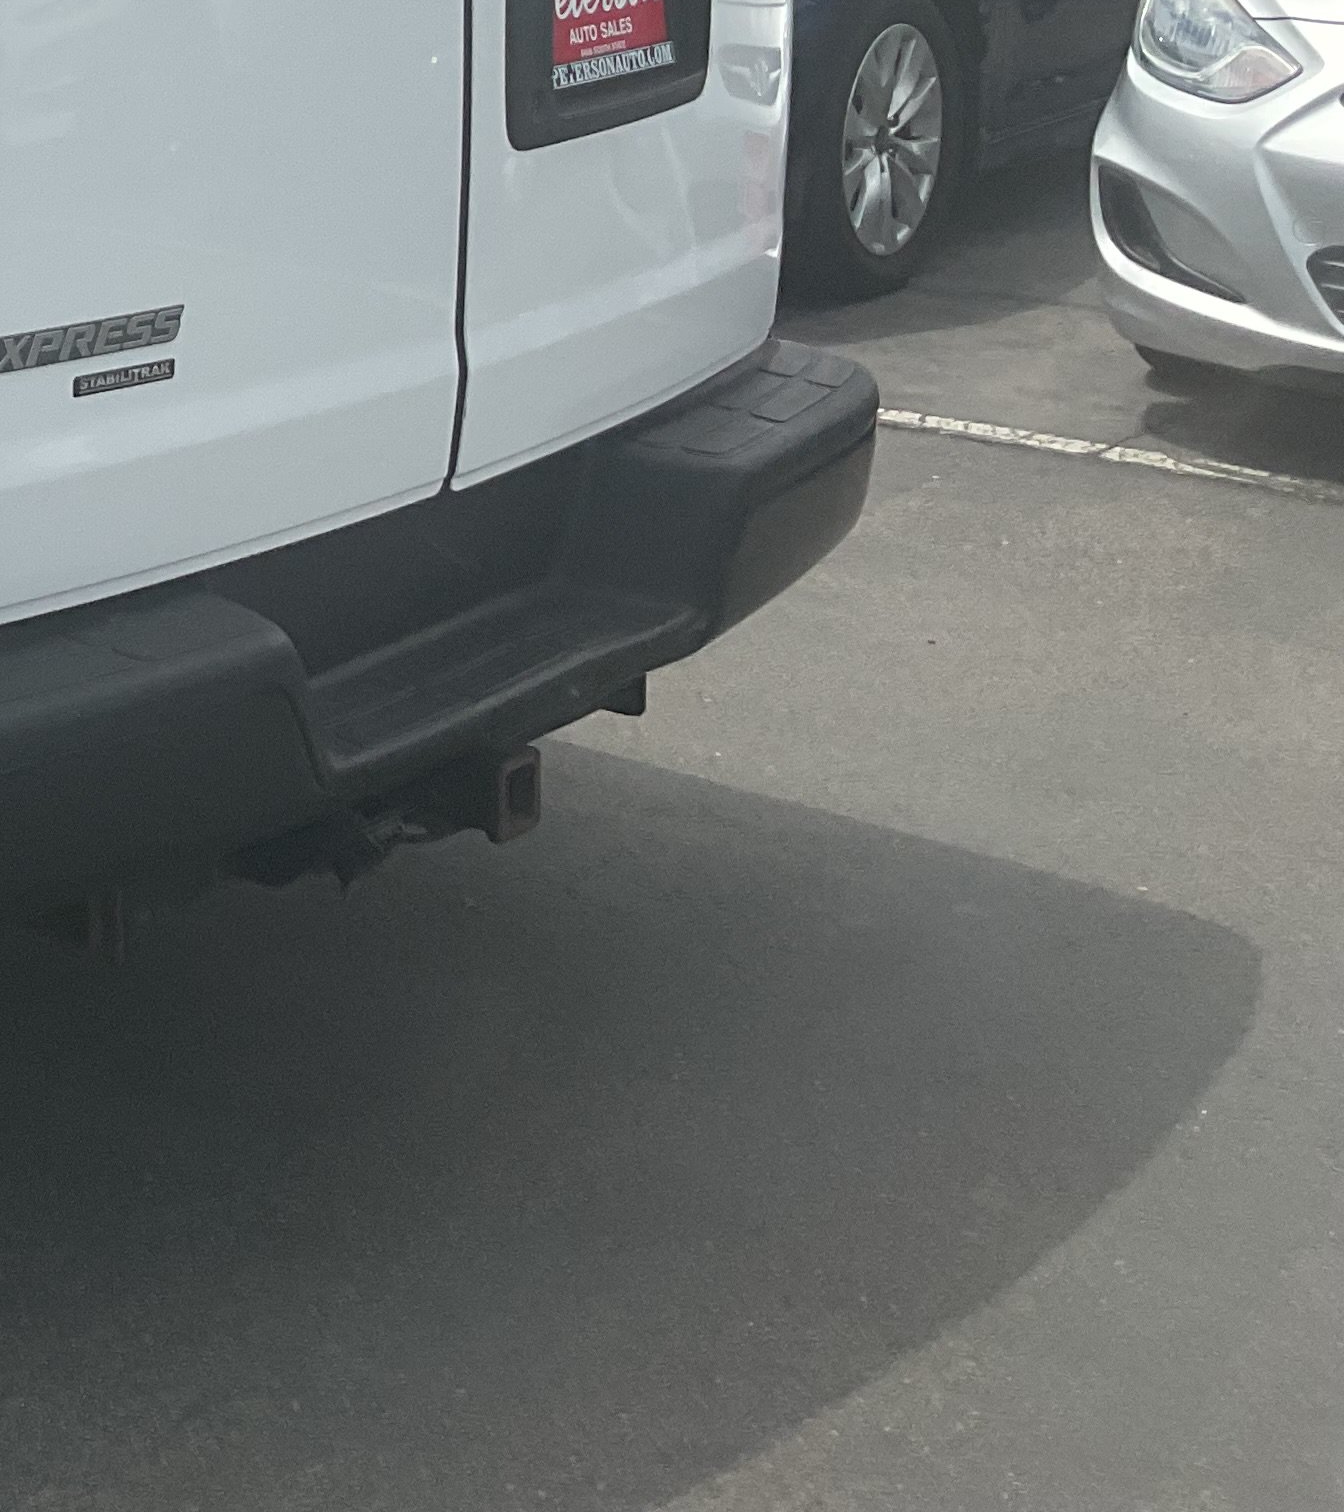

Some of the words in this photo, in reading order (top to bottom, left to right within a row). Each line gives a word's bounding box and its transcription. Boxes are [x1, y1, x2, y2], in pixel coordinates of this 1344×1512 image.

[569, 24, 598, 45] AUTO
[600, 16, 633, 39] SALES
[78, 361, 171, 390] STABILITRAK
